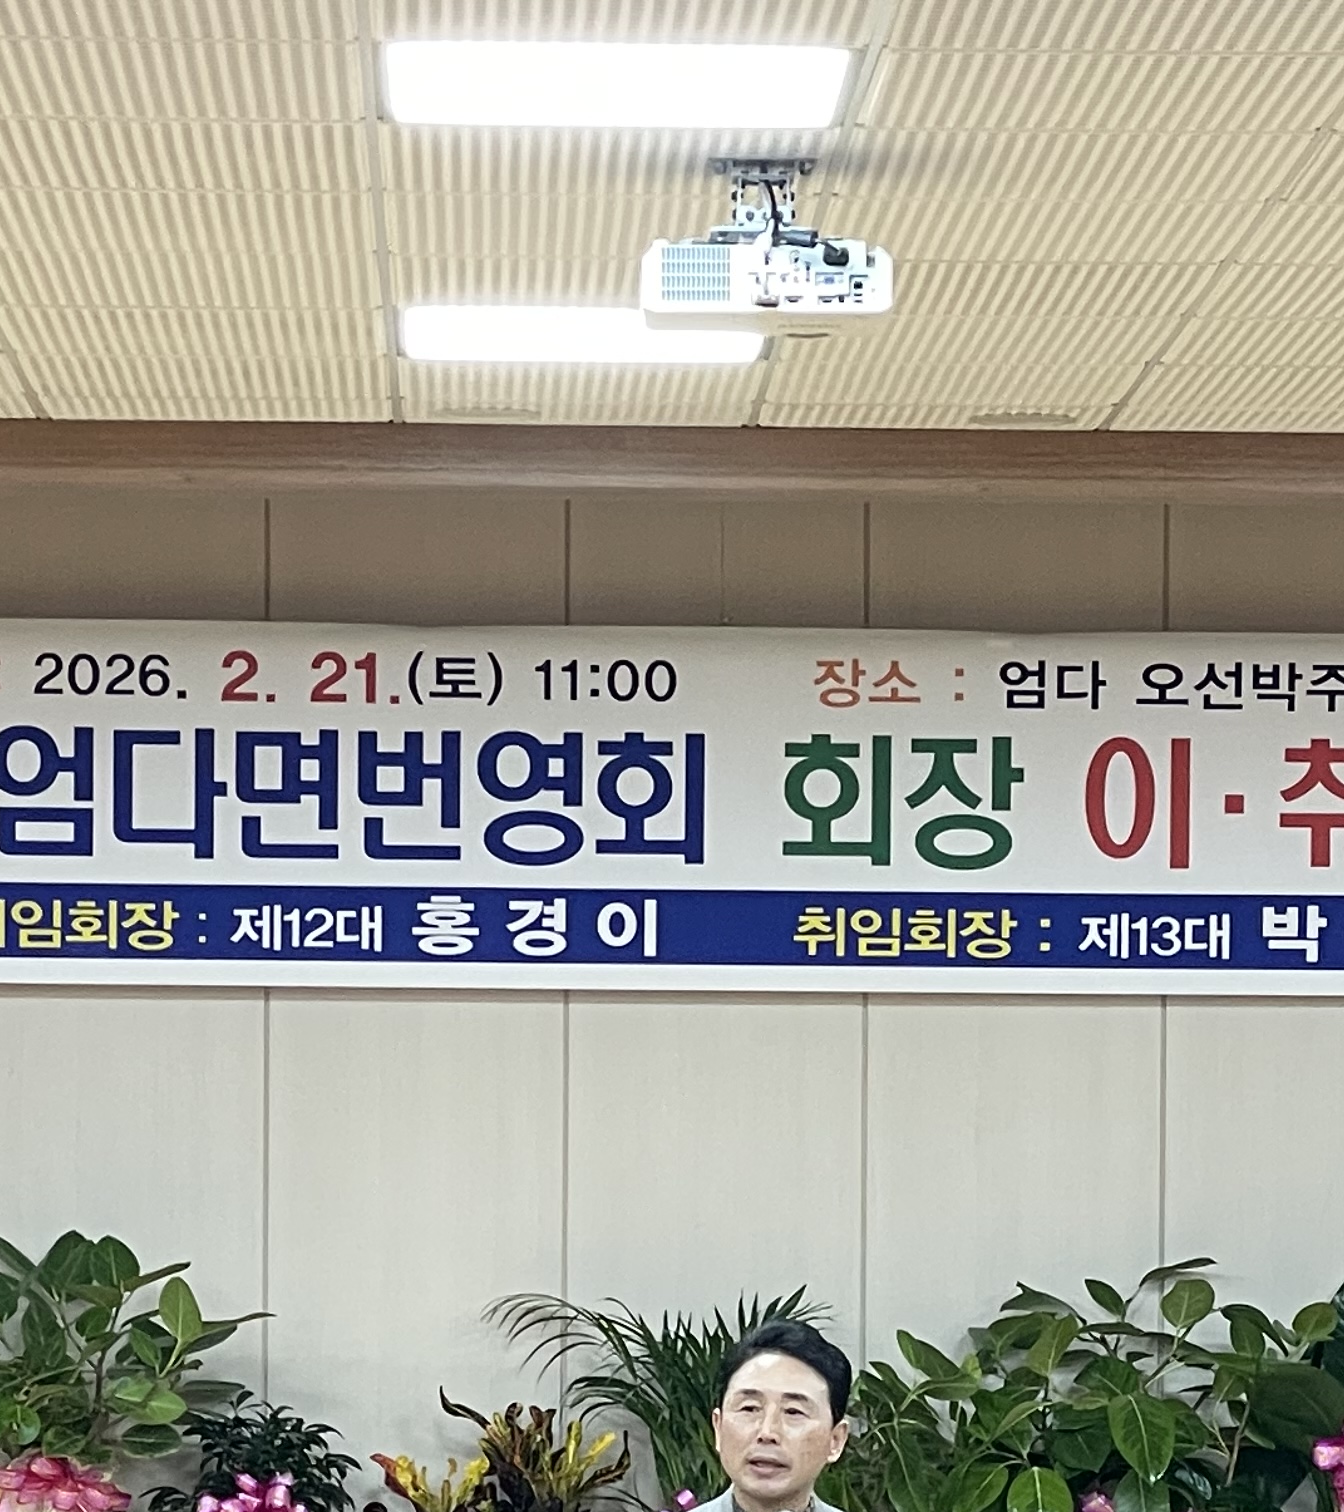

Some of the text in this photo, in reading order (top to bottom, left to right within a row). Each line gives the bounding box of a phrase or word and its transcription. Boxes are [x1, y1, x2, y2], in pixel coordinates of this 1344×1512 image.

[34, 653, 186, 699] 2026.
[222, 651, 275, 702] 2.
[311, 651, 502, 706] 21.(토)
[535, 660, 676, 701] 11:00
[815, 659, 920, 707] 장소
[1000, 660, 1106, 709] 엄다
[783, 734, 1024, 870] 회장
[231, 905, 382, 951] 제12대
[794, 908, 1017, 958] 취임회장
[1079, 913, 1230, 959] 제13대
